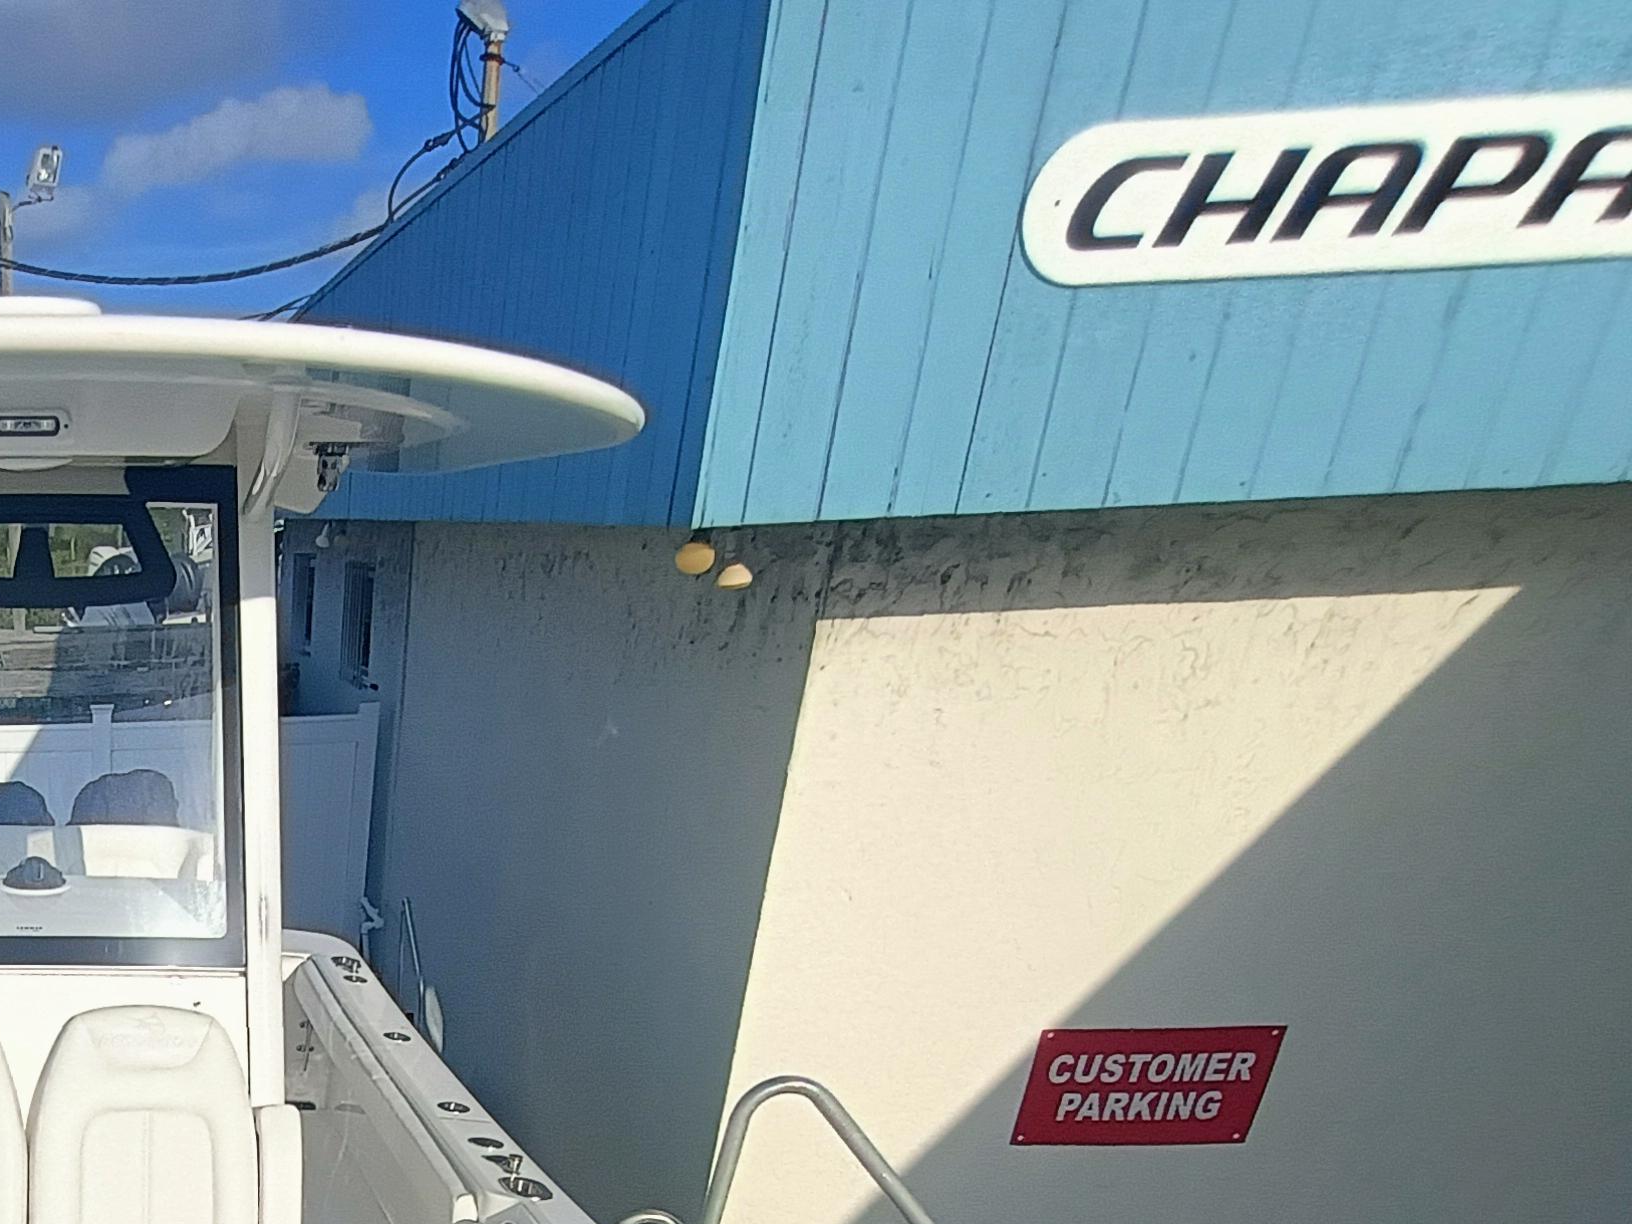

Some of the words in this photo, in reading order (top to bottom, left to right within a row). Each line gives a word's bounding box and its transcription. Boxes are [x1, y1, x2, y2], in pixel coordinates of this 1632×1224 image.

[1065, 125, 1632, 252] CHAPA
[1048, 1051, 1257, 1085] CUSTOMER
[1055, 1090, 1224, 1122] PARKING
